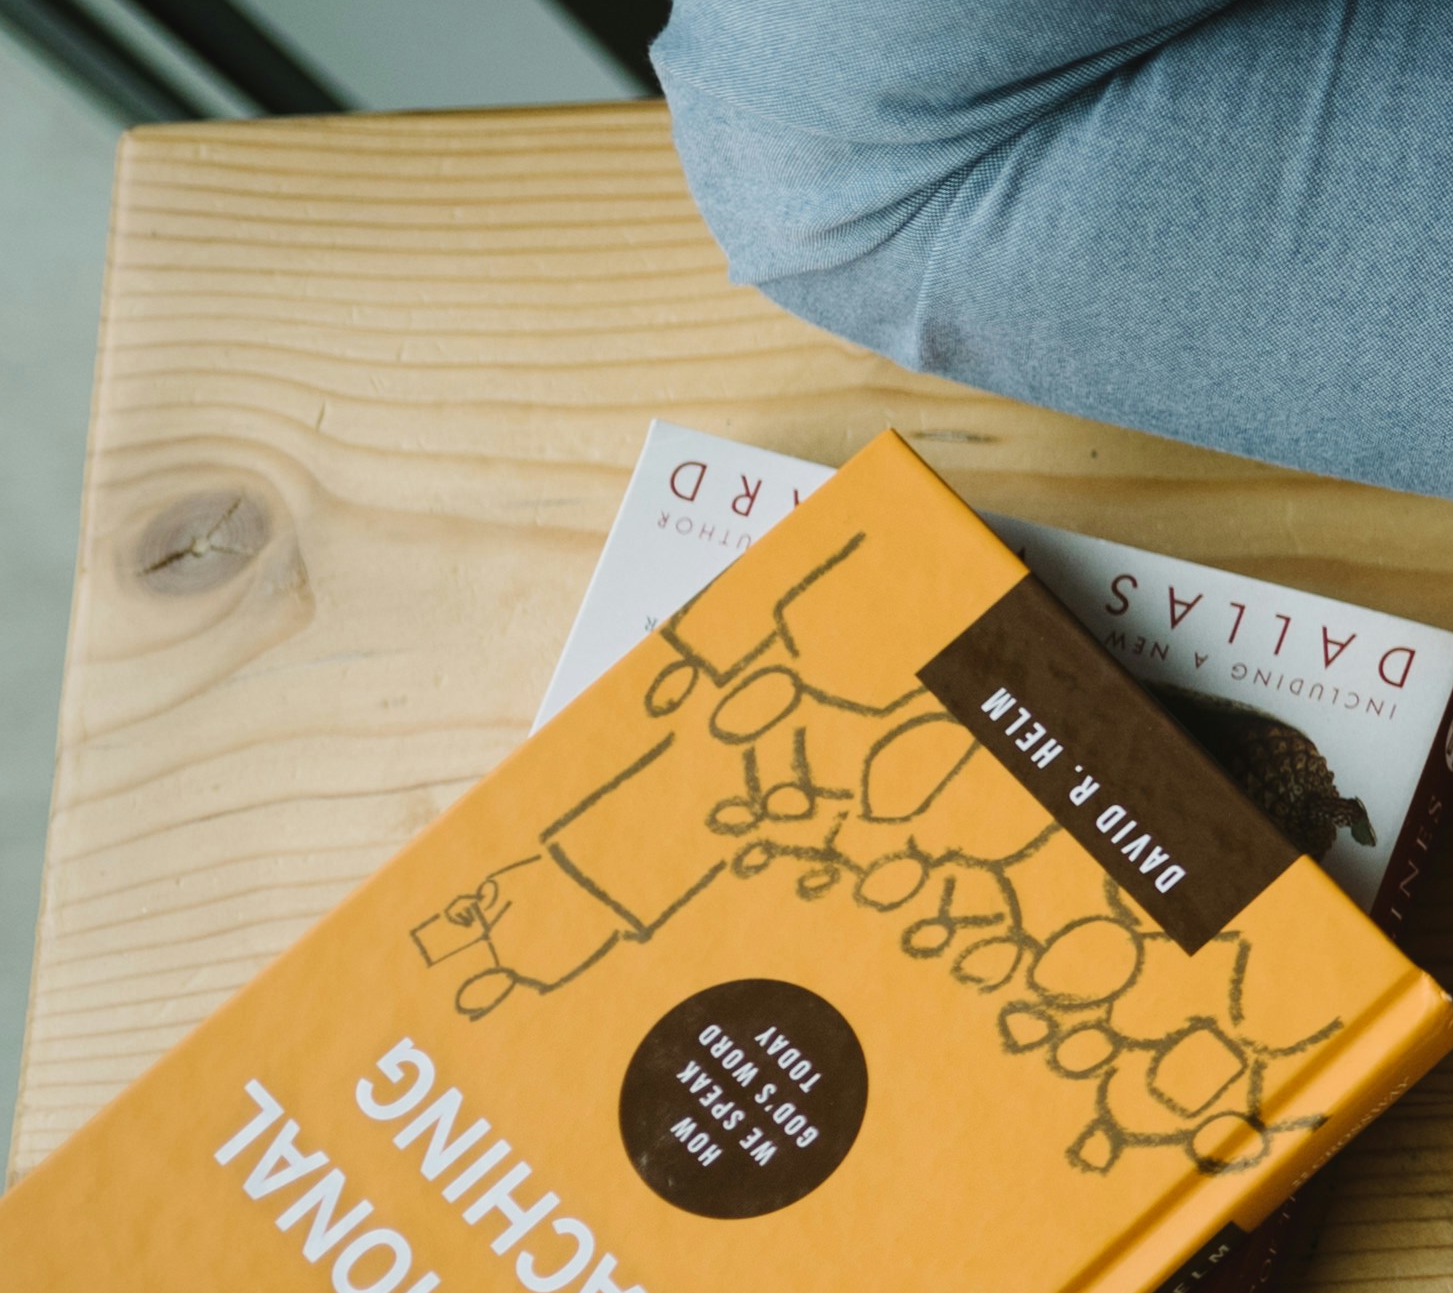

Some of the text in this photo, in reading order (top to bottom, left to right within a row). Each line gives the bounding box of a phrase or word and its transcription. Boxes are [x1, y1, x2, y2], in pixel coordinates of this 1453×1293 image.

[657, 509, 752, 550] UTHOR
[1105, 573, 1416, 689] DALLAS
[1105, 630, 1397, 719] INCLUDING A NEW
[980, 687, 1187, 894] DAVID R. HELM
[698, 1024, 819, 1148] GOD'S WORD
[754, 1026, 822, 1093] TODAY
[670, 1117, 723, 1167] HOW
[676, 1060, 778, 1166] WE SPEAK
